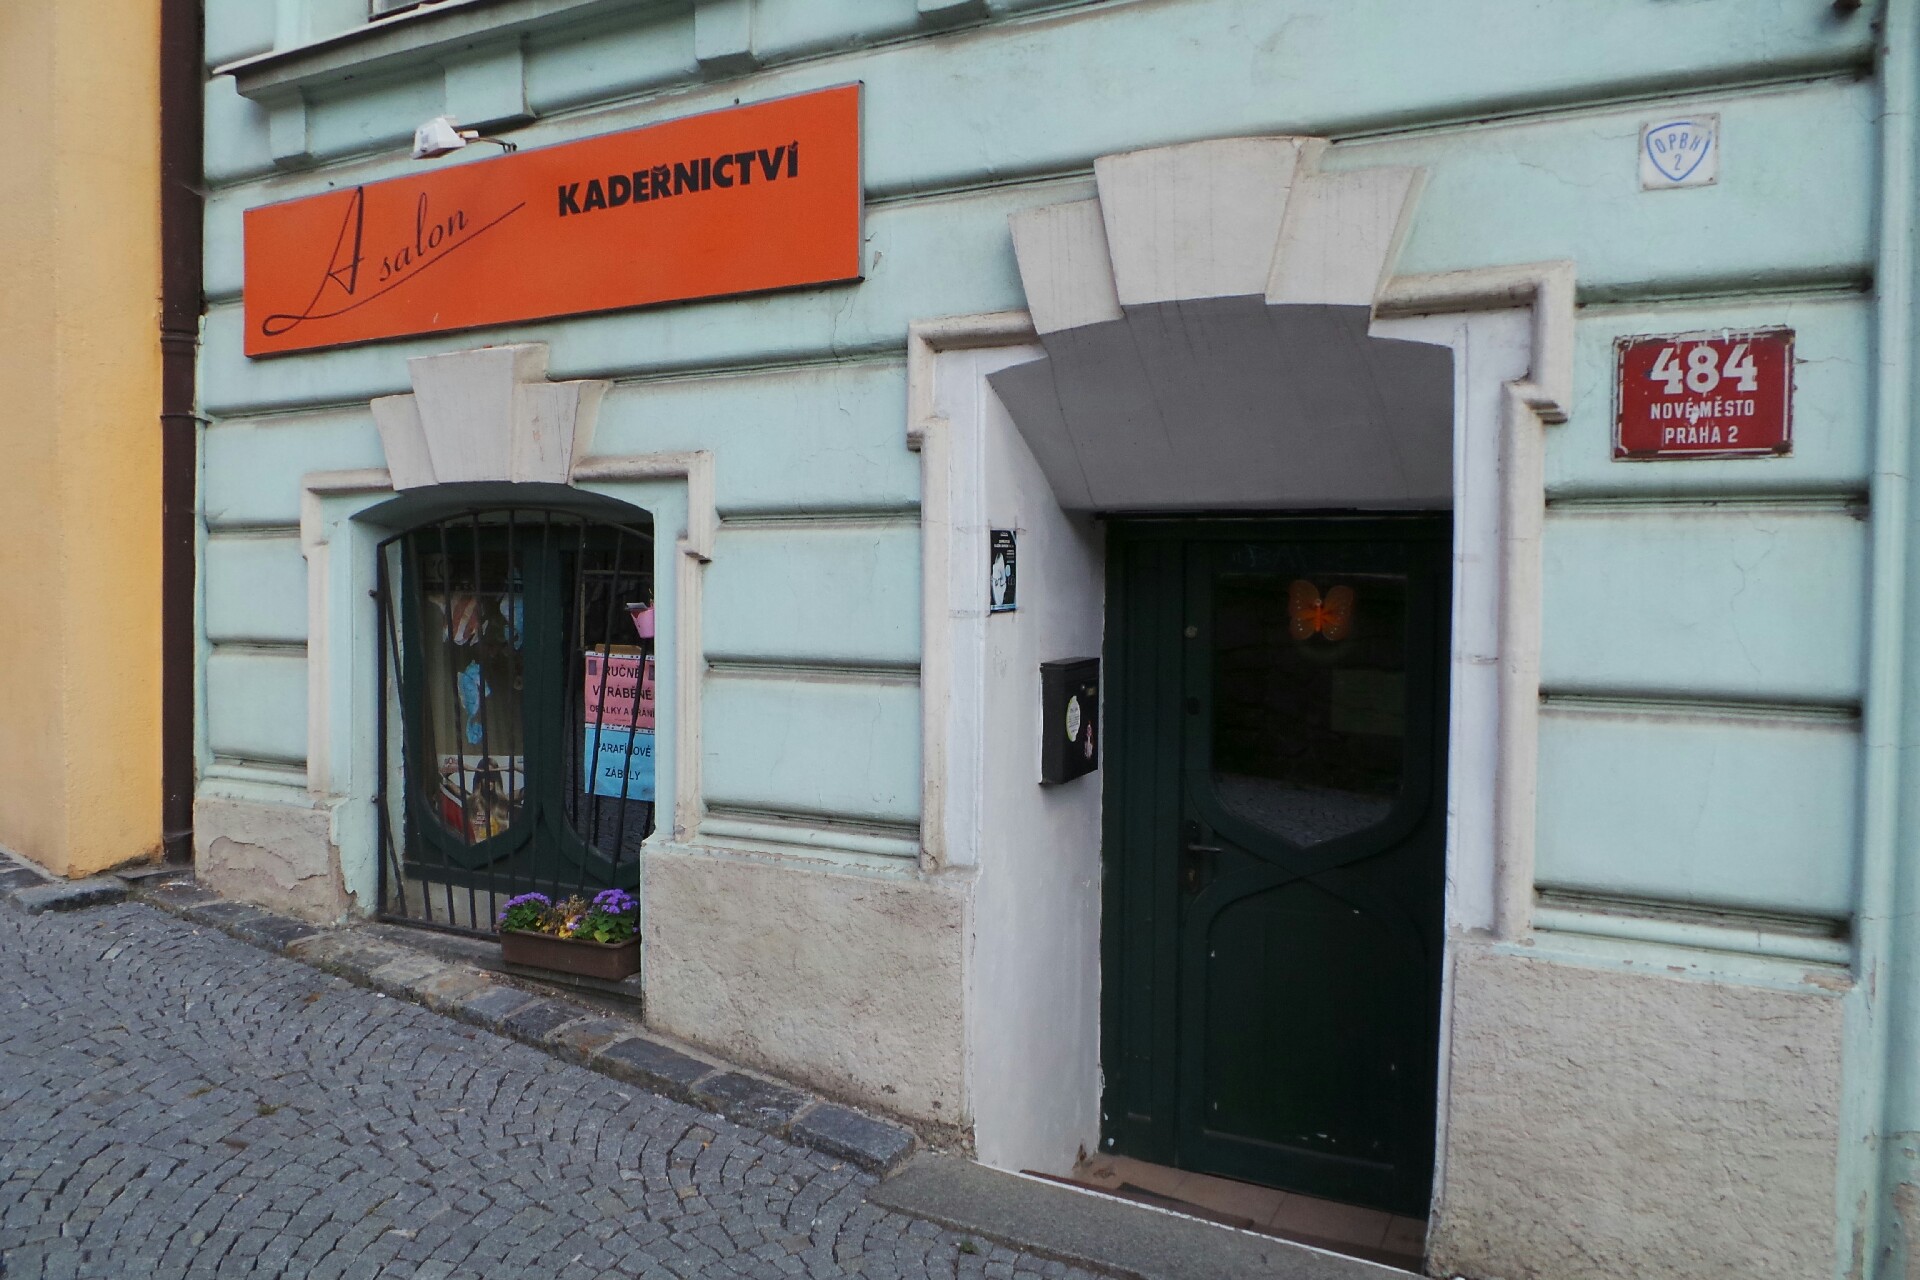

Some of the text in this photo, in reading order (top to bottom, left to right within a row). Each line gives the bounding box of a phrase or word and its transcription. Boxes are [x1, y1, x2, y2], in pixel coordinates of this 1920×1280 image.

[1674, 153, 1682, 171] 2
[557, 140, 799, 217] KADEŘNICTVÍ
[379, 191, 469, 282] salon
[1650, 343, 1758, 395] 484
[1650, 396, 1755, 419] NOVÉ MĚSTO
[1664, 425, 1739, 444] PRAHA 2
[592, 684, 653, 701] VRÁBĚNÉ
[598, 743, 652, 757] ARAFÍOVÉ
[604, 767, 641, 780] ZÁBLY
